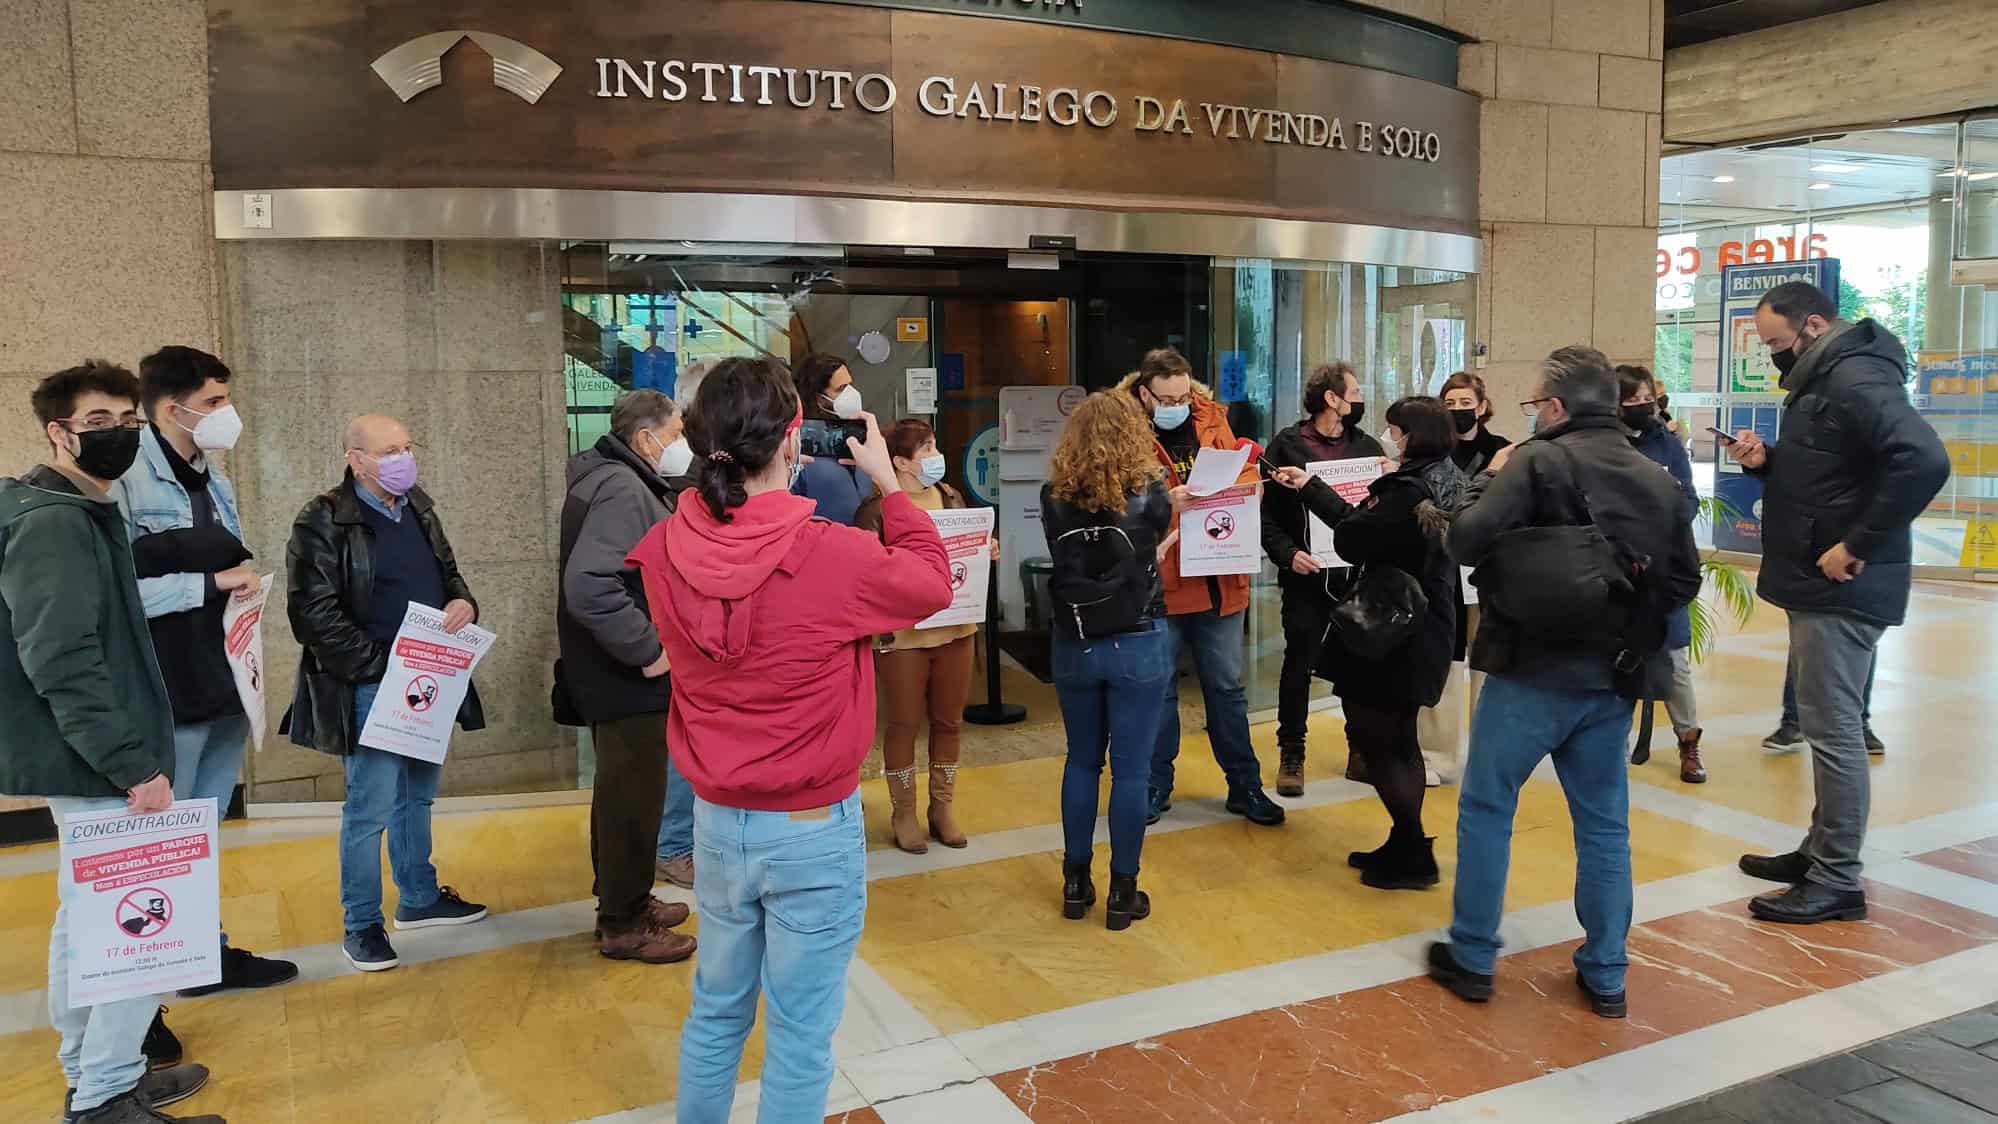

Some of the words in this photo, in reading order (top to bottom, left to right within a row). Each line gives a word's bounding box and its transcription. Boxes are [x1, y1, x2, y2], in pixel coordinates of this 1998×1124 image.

[595, 58, 897, 112] INSTITUTO
[918, 76, 1118, 127] GALEGO
[1134, 96, 1193, 134] DA
[1200, 103, 1347, 149] VIVENDA
[1357, 121, 1372, 152] E
[1381, 124, 1440, 162] SOLO
[72, 810, 201, 839] CONCENTRACIÓN
[162, 835, 206, 851] PARQUE
[98, 859, 149, 874] VIVENDA
[106, 947, 119, 959] 17
[122, 944, 136, 957] de
[139, 938, 184, 954] Febreiro
